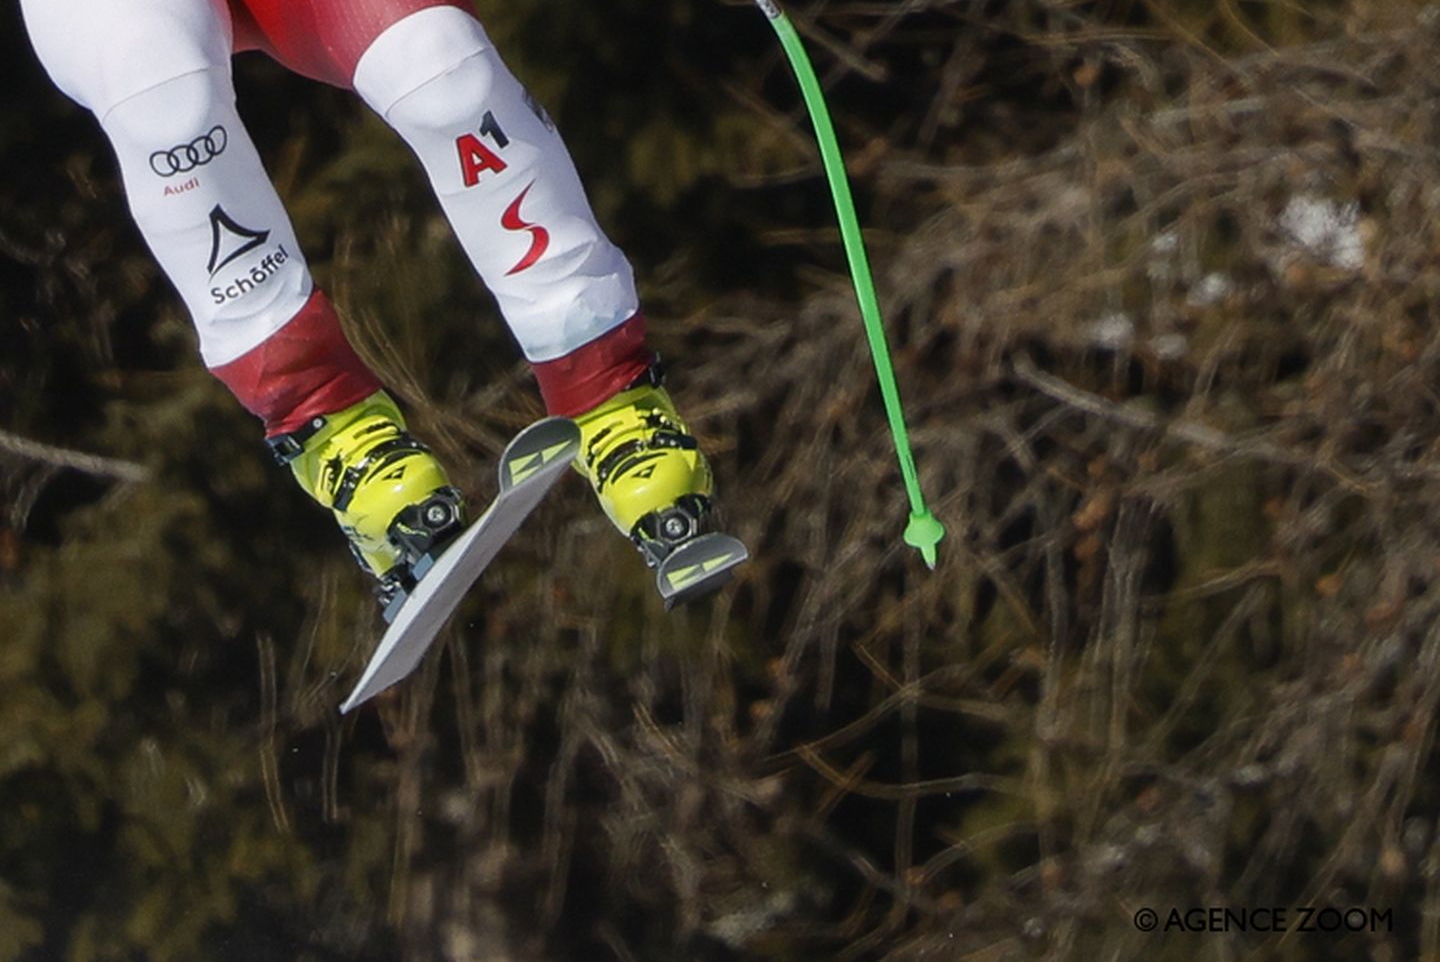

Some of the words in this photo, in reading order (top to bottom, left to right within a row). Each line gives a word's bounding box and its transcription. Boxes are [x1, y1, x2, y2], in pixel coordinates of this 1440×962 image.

[454, 110, 511, 187] A1
[163, 176, 200, 197] Audi
[210, 244, 291, 305] Schöffel
